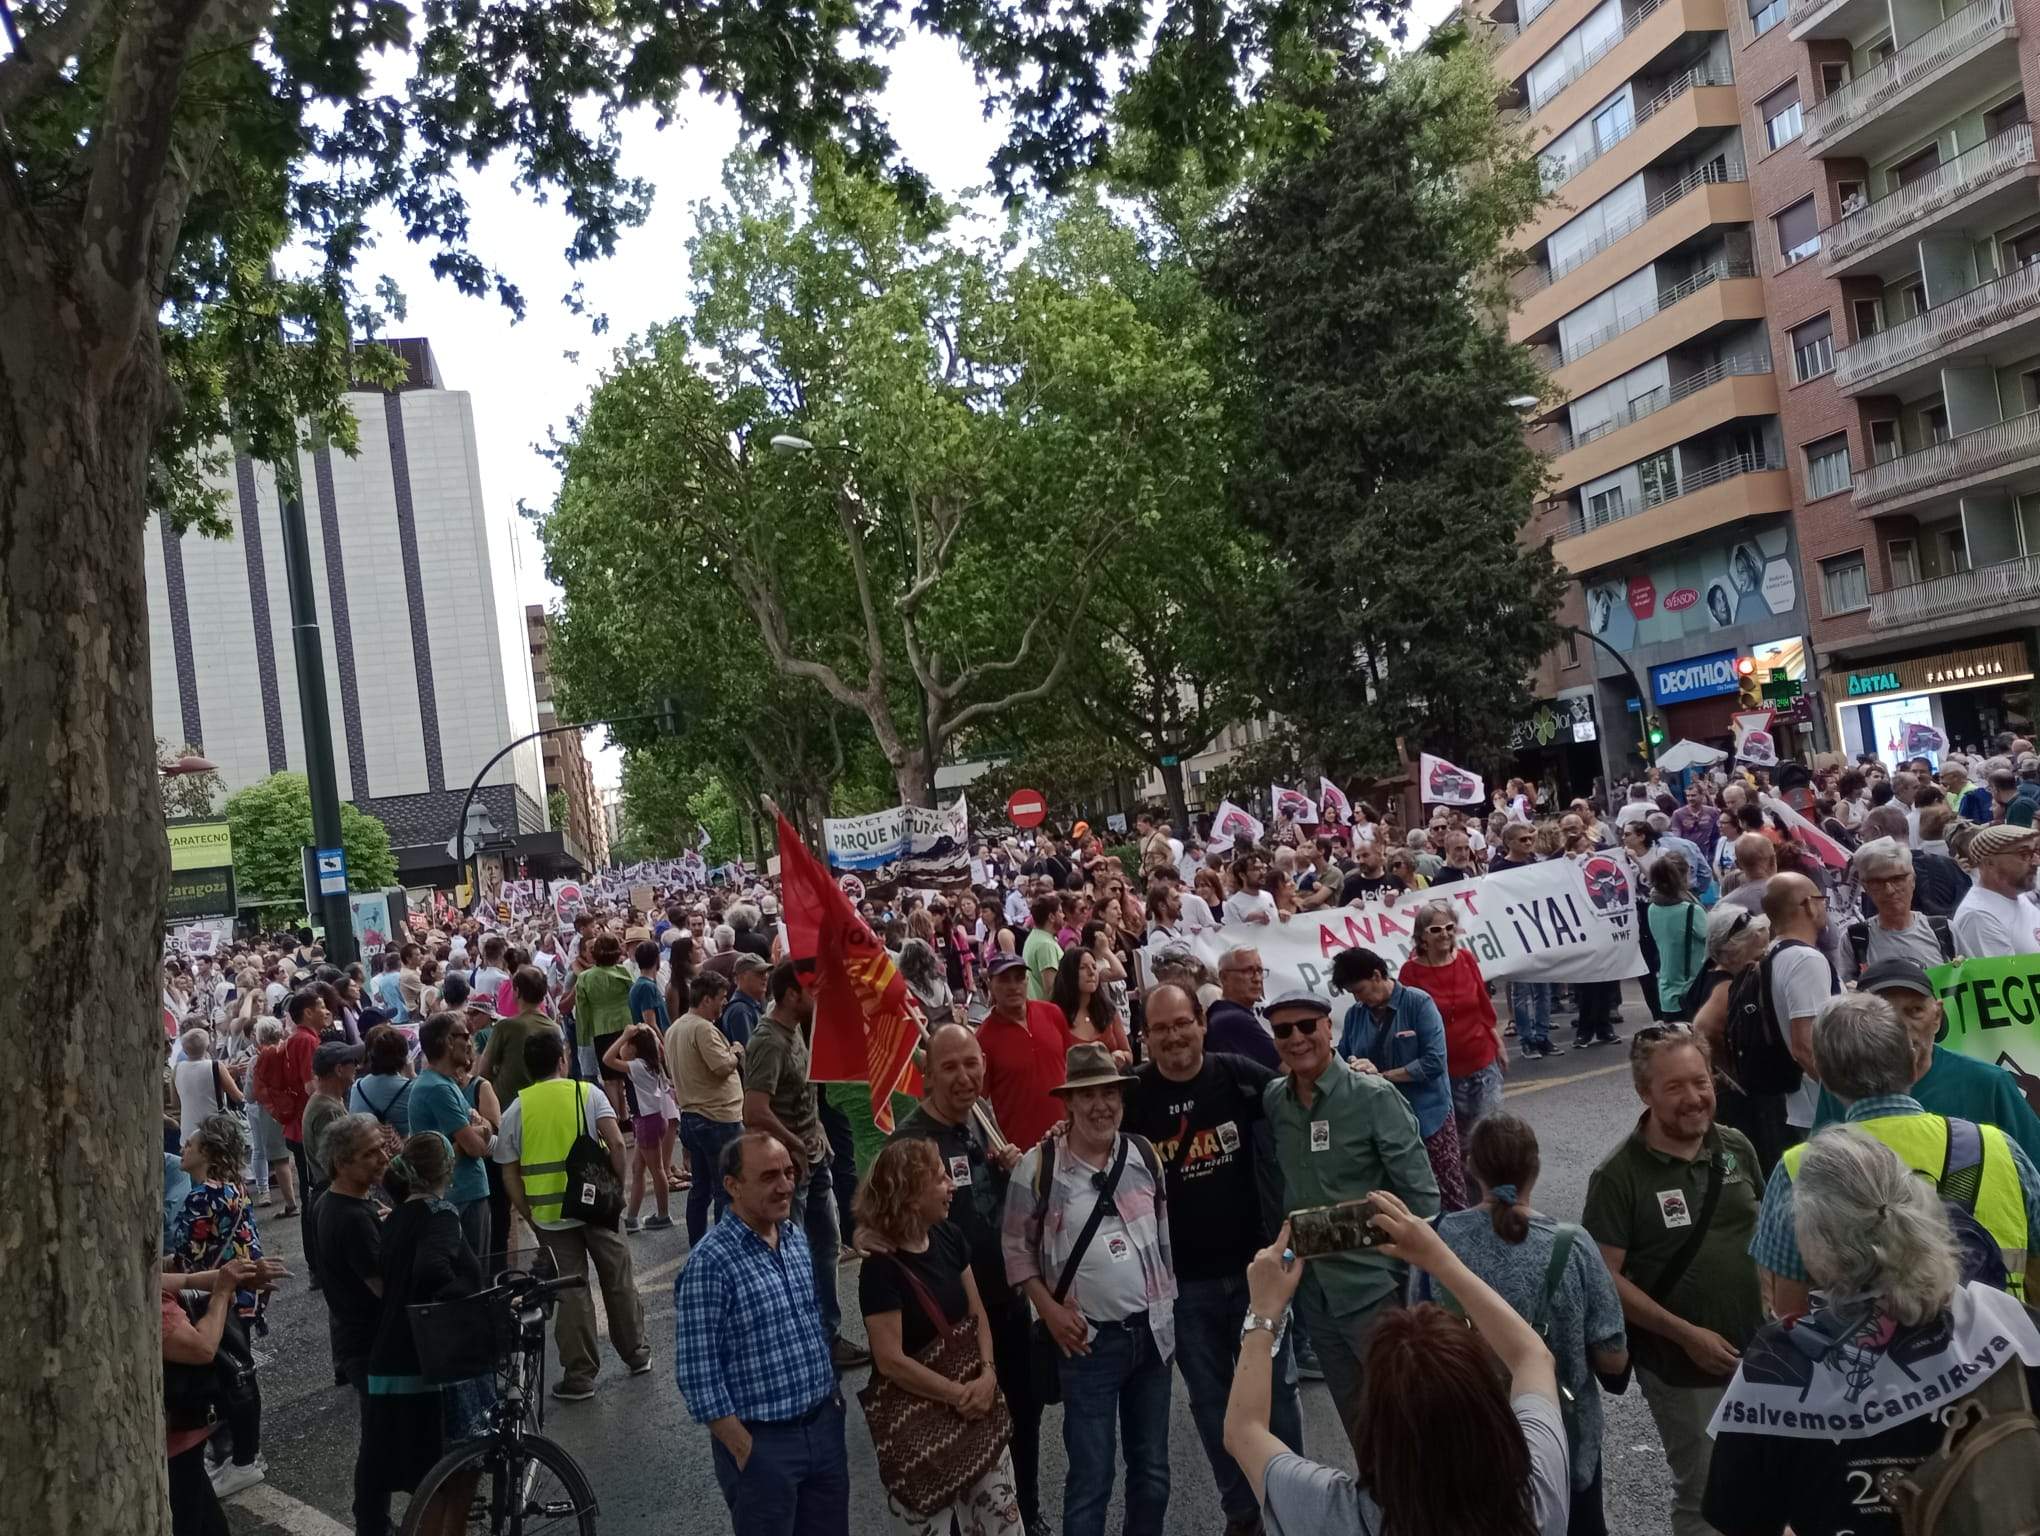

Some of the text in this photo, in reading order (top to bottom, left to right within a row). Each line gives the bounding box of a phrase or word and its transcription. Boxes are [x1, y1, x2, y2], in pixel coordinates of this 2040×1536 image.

[1664, 588, 1699, 609] SVENSON
[1659, 659, 1739, 695] DECATHLON
[1848, 672, 1900, 696] ARTAL
[1926, 661, 2004, 684] FARMACIA
[834, 828, 888, 851] PARQUE
[1318, 889, 1479, 959] ANAYT
[1611, 929, 1632, 943] WWF
[1721, 1333, 2013, 1432] #SalvemosCanalRoya
